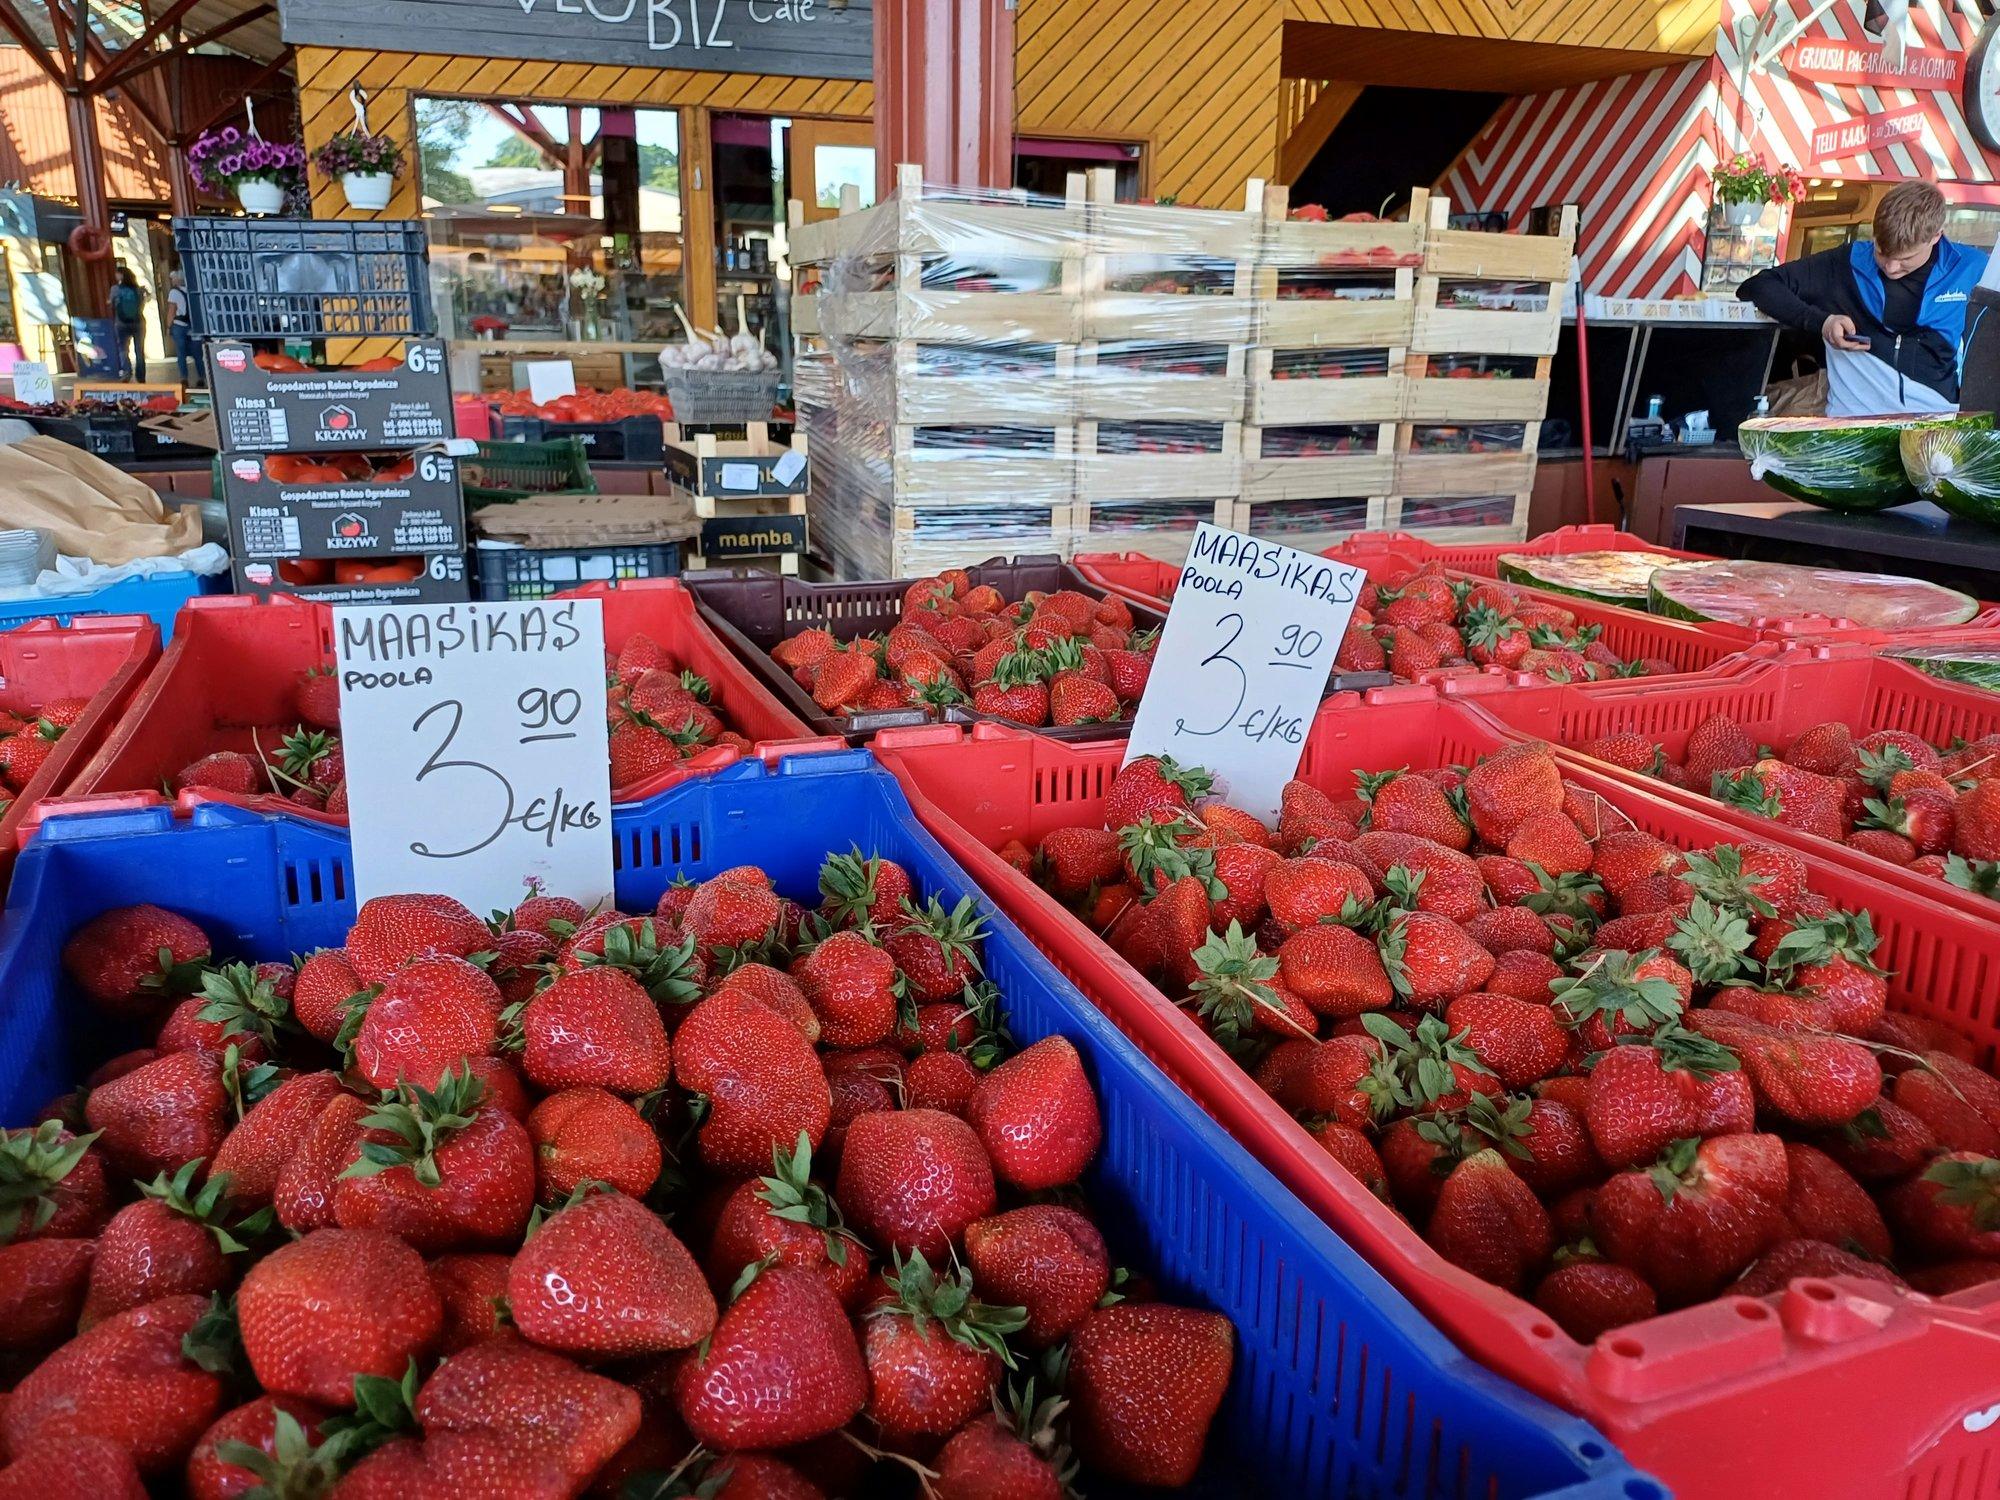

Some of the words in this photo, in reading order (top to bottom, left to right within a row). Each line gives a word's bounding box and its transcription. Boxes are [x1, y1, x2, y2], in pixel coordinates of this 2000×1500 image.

[1799, 46, 1843, 72] GRUUSIA
[1909, 60, 1918, 74] &
[1919, 57, 1956, 80] KOHVIK
[1815, 130, 1838, 154] TELLI
[1840, 123, 1870, 149] KAASA
[408, 344, 426, 373] 6
[426, 361, 440, 375] kg
[266, 381, 327, 394] Gospodarstwo
[352, 378, 399, 392] Ogrodnicze
[235, 397, 266, 409] Klasa
[268, 396, 276, 408] 1
[315, 429, 368, 441] KRZYWY
[420, 455, 437, 482] 6
[438, 470, 451, 483] kg
[281, 490, 340, 503] Gospodarstwo
[365, 488, 411, 502] Ogrodnicze
[249, 506, 280, 517] Klasa
[282, 505, 289, 517] 1
[327, 537, 379, 550] KRZYWY
[719, 530, 793, 548] mamba
[430, 555, 444, 581] 6
[448, 568, 462, 582] kg
[1182, 567, 1243, 600] POOLA
[344, 666, 433, 692] POOLA
[1175, 613, 1246, 736] 3
[1274, 624, 1322, 658] 90
[409, 700, 514, 858] 3
[517, 688, 581, 728] 90
